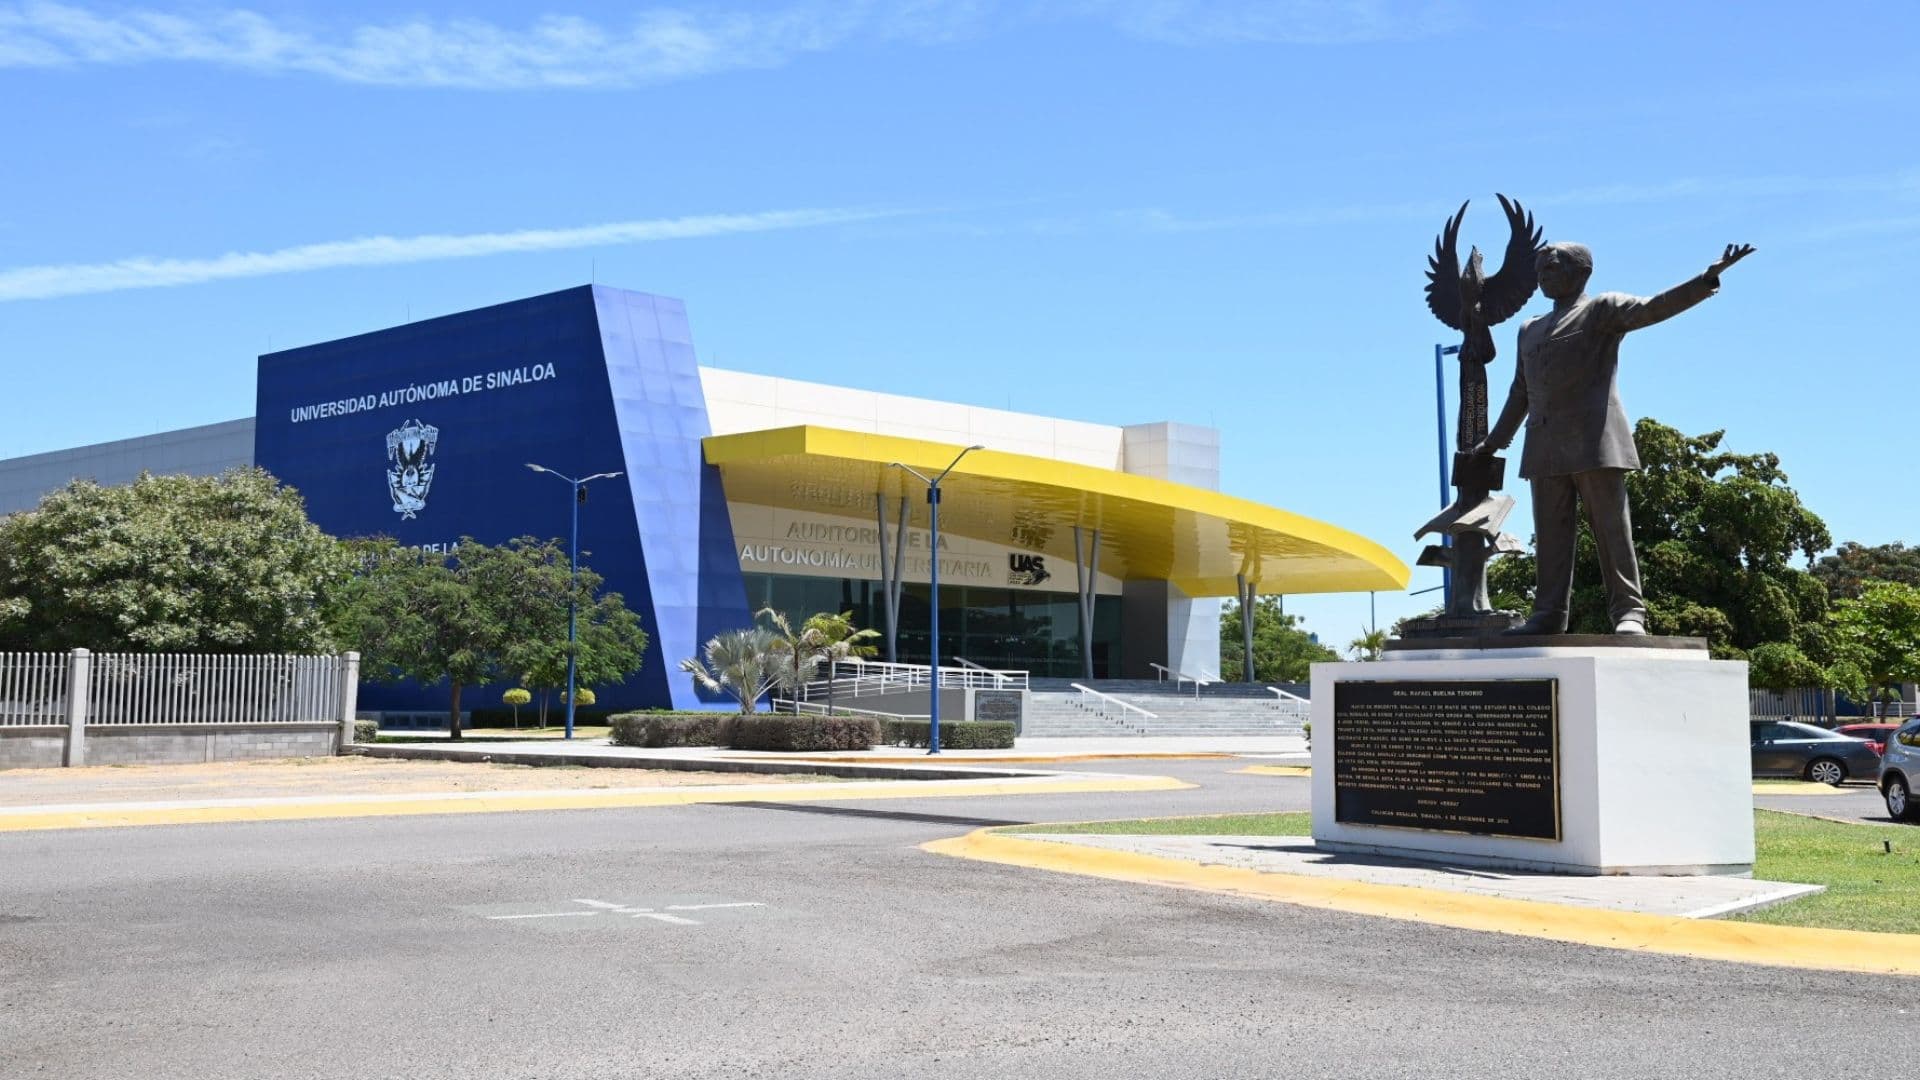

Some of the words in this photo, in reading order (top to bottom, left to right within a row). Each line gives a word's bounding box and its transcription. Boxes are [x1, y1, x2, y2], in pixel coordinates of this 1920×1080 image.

[290, 394, 376, 424] UNIVERSIDAD
[379, 378, 459, 409] AUTÓNOMA
[462, 375, 483, 393] DE
[486, 362, 556, 390] SINALOA
[786, 521, 890, 545] AUDITORI
[740, 544, 858, 569] AUTONOMÍA
[1009, 552, 1045, 573] UAS
